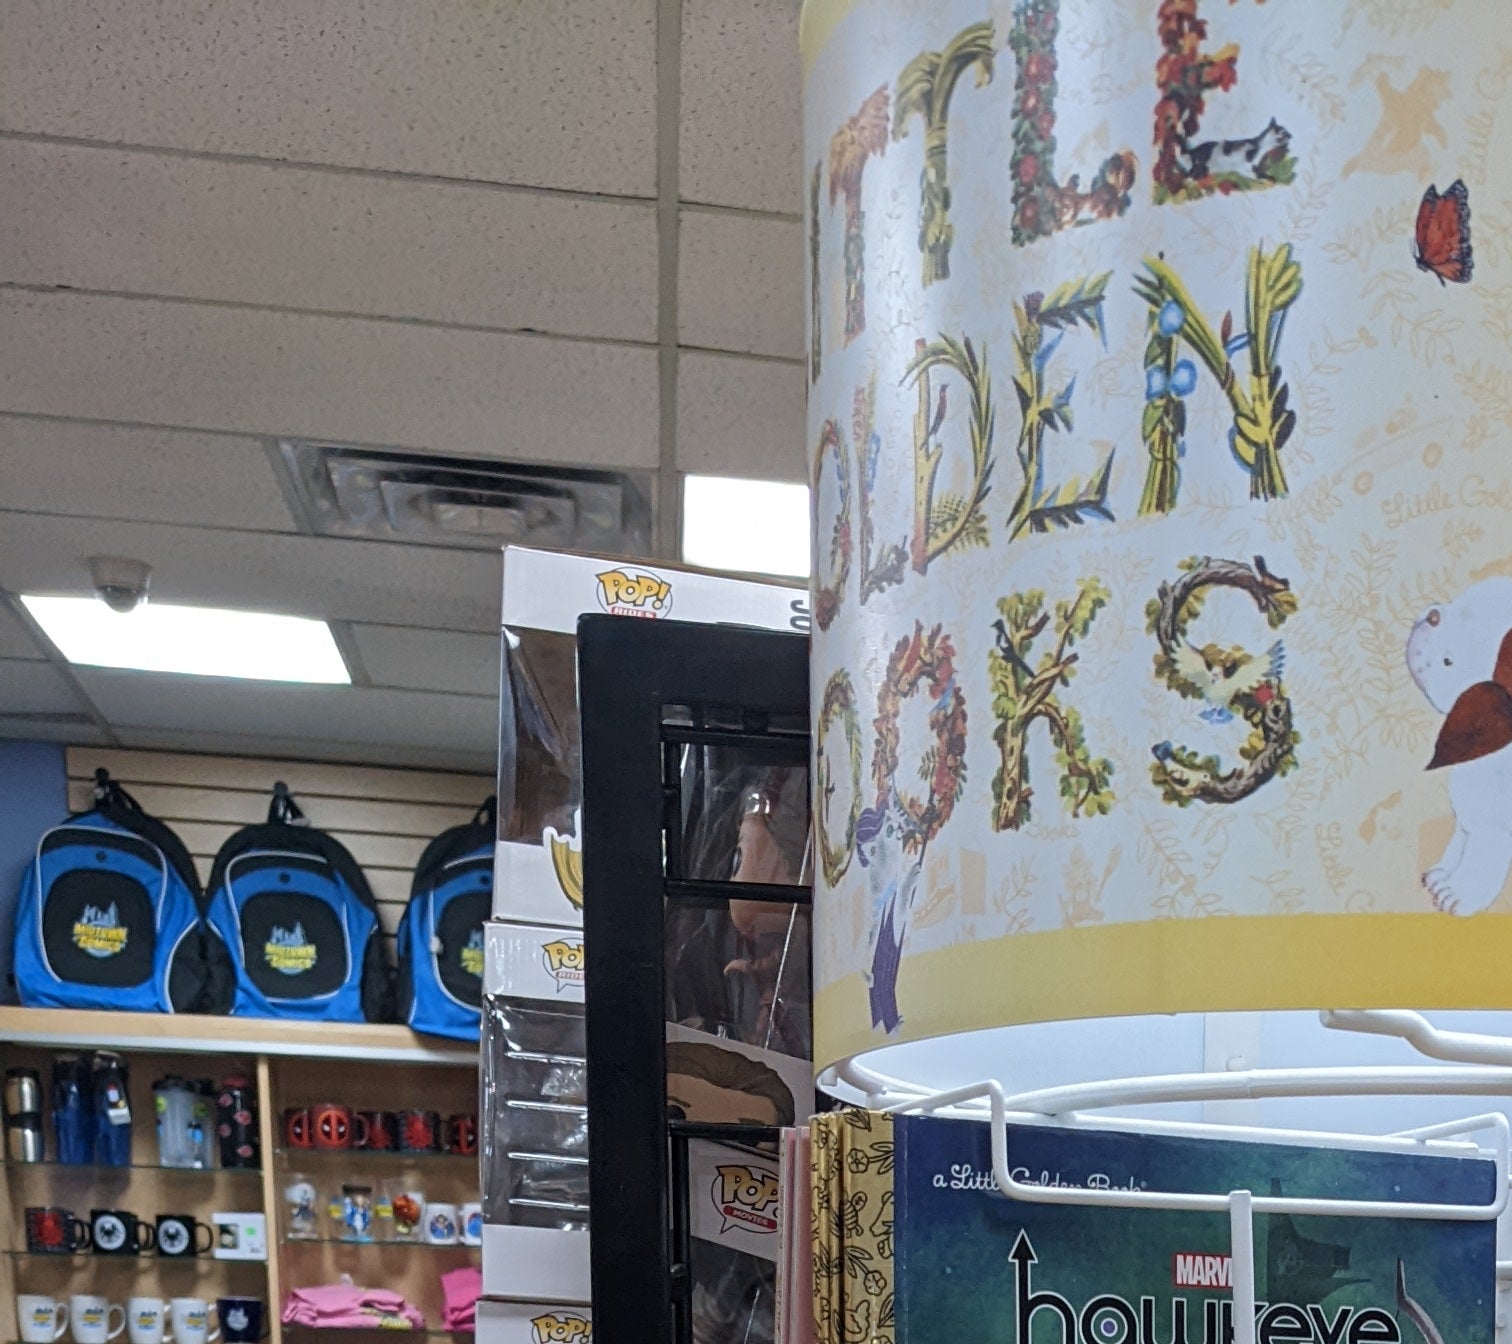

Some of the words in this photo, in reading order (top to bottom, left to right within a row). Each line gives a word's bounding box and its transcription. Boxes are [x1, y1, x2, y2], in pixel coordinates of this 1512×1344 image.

[596, 570, 673, 610] POP!
[932, 1173, 948, 1189] a
[951, 1164, 1000, 1191] Littl
[1174, 1253, 1235, 1288] MARV
